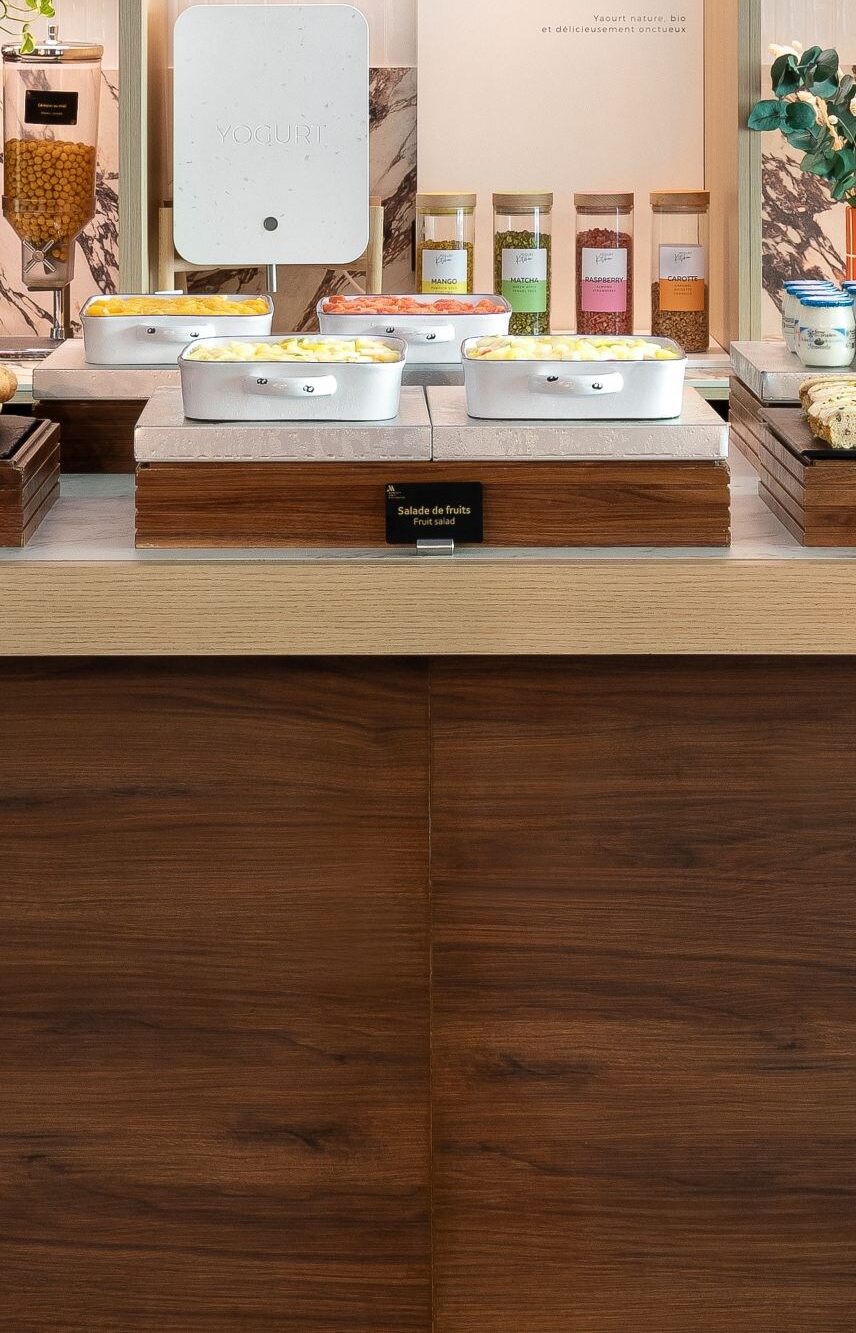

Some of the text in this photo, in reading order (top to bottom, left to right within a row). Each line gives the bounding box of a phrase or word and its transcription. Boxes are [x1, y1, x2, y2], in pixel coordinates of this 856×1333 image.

[593, 14, 626, 23] Yaourt
[670, 14, 687, 23] bio
[541, 24, 687, 34] et délicieusement onctueux
[216, 124, 327, 144] YOGURT
[584, 276, 624, 284] RASPBERRY
[397, 505, 472, 516] Salade de fruits
[413, 516, 456, 526] Fruit salad
